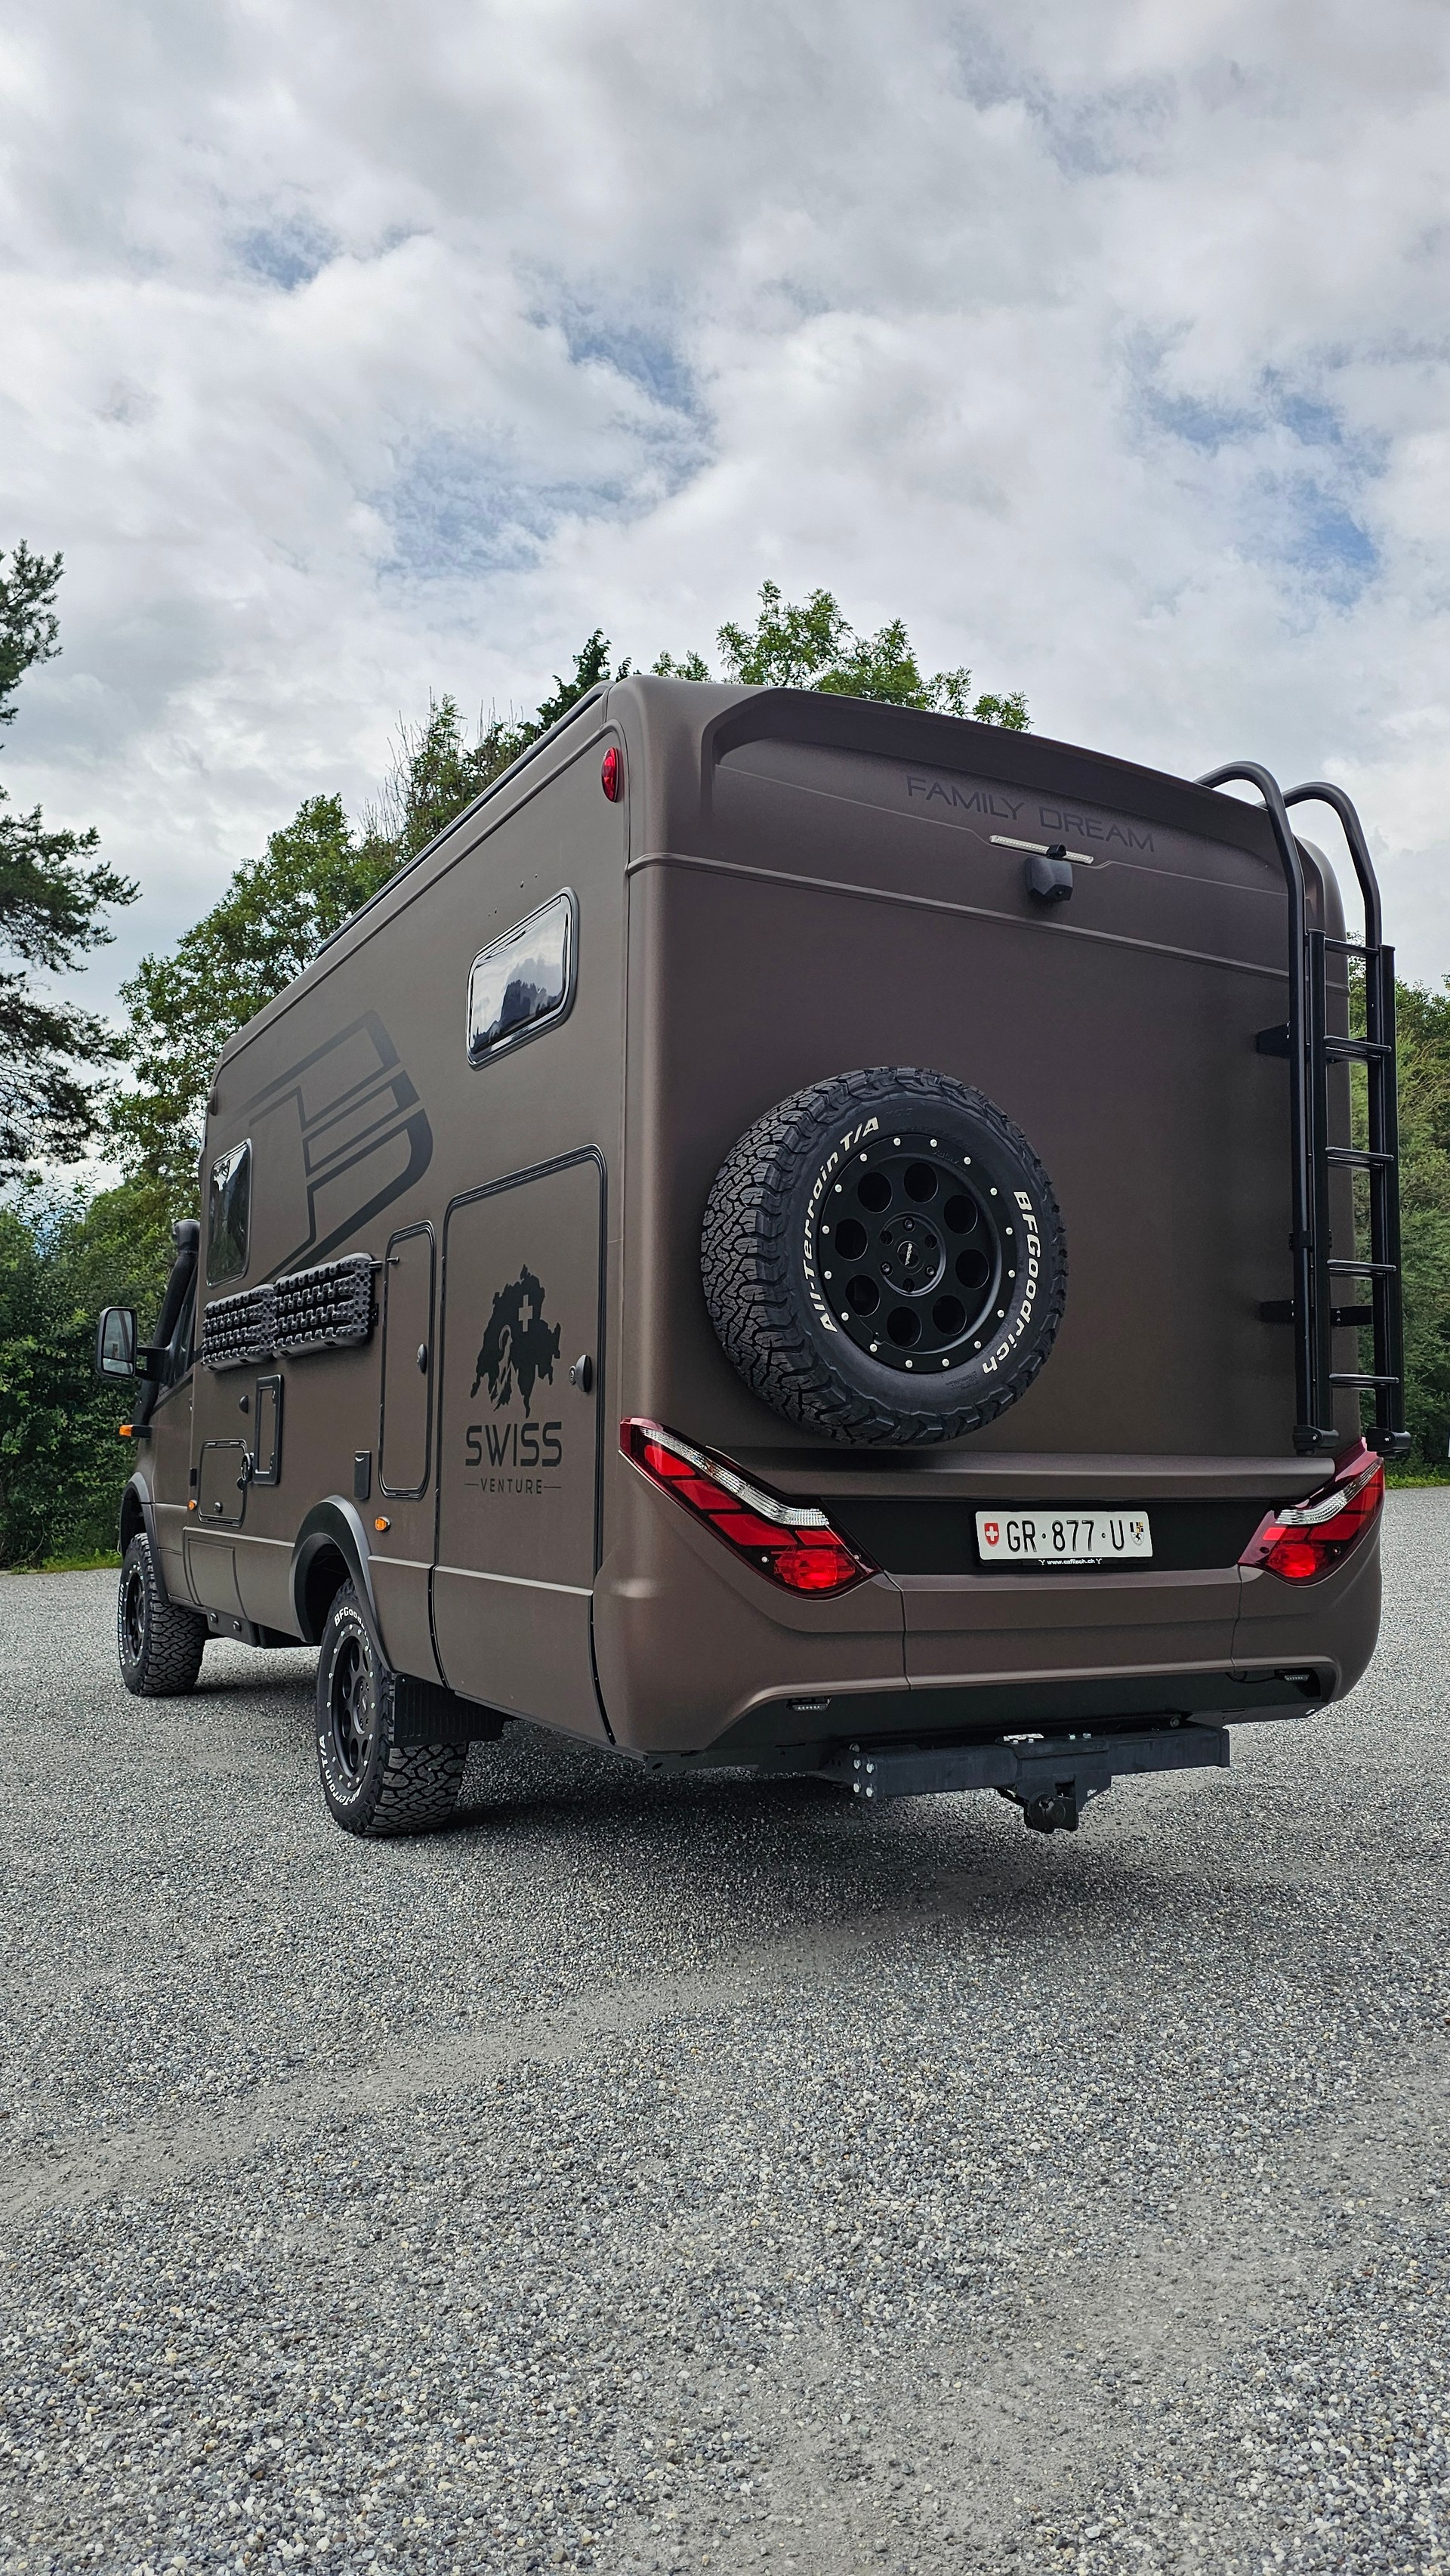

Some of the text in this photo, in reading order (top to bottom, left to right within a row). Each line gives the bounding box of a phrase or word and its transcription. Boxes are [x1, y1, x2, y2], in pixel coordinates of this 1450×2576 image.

[906, 776, 1155, 852] FAMILY DREAM
[803, 1117, 879, 1333] All-Terrain T/A
[981, 1191, 1041, 1374] BFGoodrich
[465, 1421, 562, 1467] SWISS
[480, 1478, 542, 1494] VENTURE
